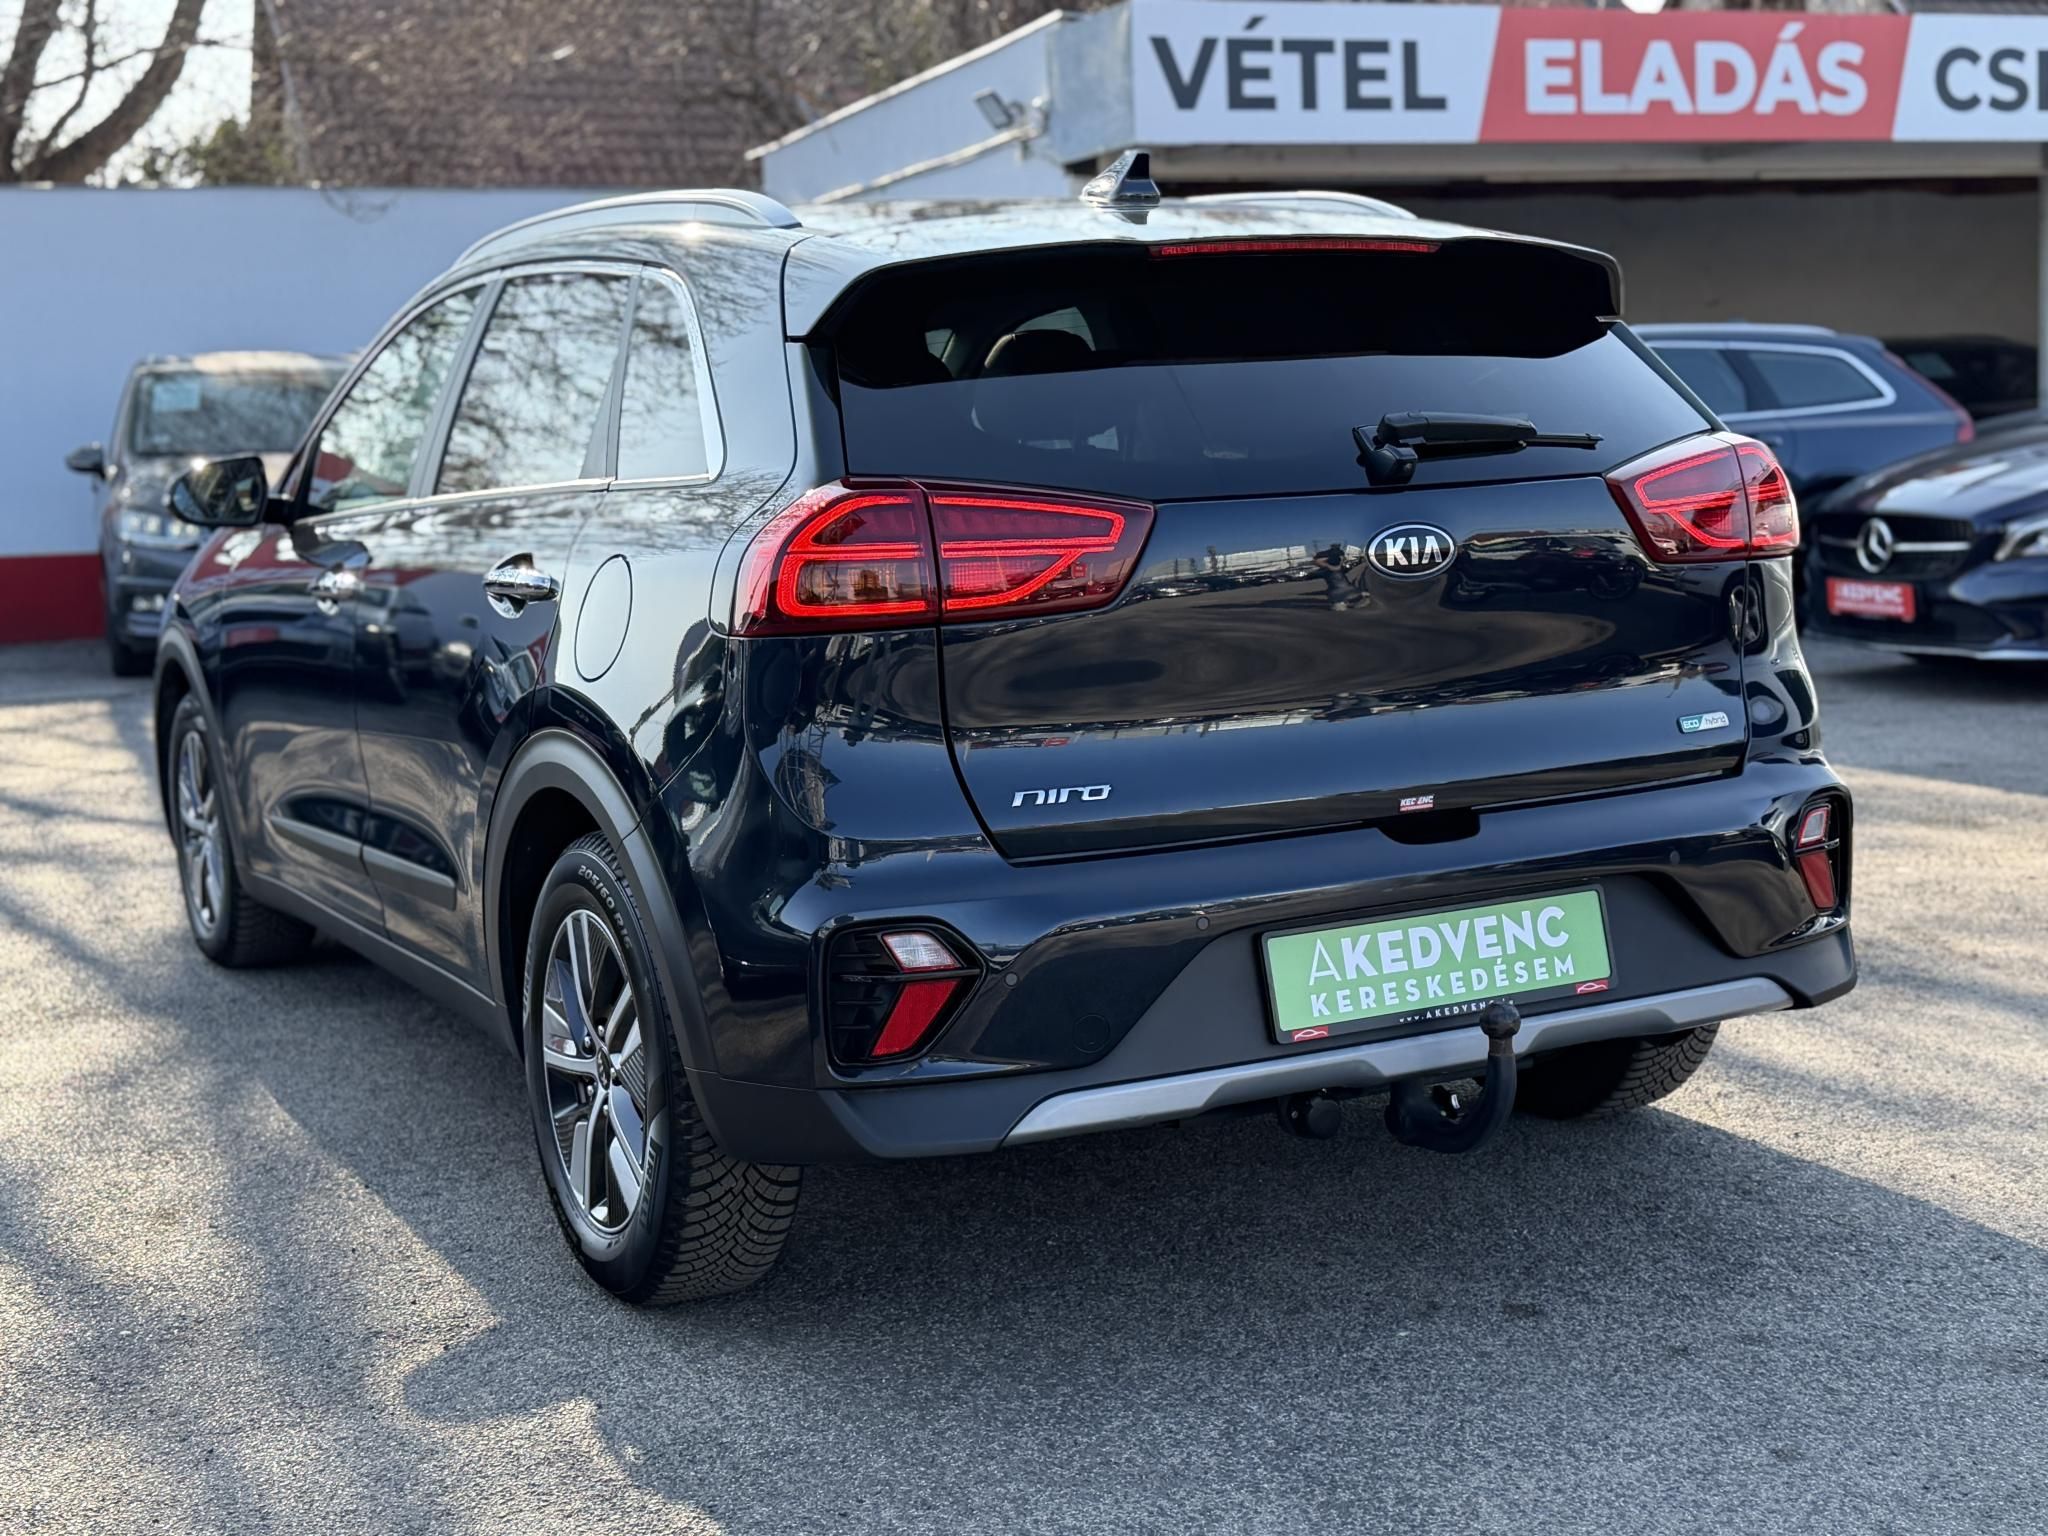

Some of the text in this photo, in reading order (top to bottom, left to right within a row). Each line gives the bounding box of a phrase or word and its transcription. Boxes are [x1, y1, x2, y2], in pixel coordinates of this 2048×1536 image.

[1149, 16, 1448, 111] VÉTEL
[1524, 21, 1868, 115] ELADÁS
[1384, 535, 1443, 567] KIA
[1682, 719, 1700, 730] ECO
[577, 864, 615, 910] 205/60
[1310, 953, 1577, 1018] KERESKEDÉSEM
